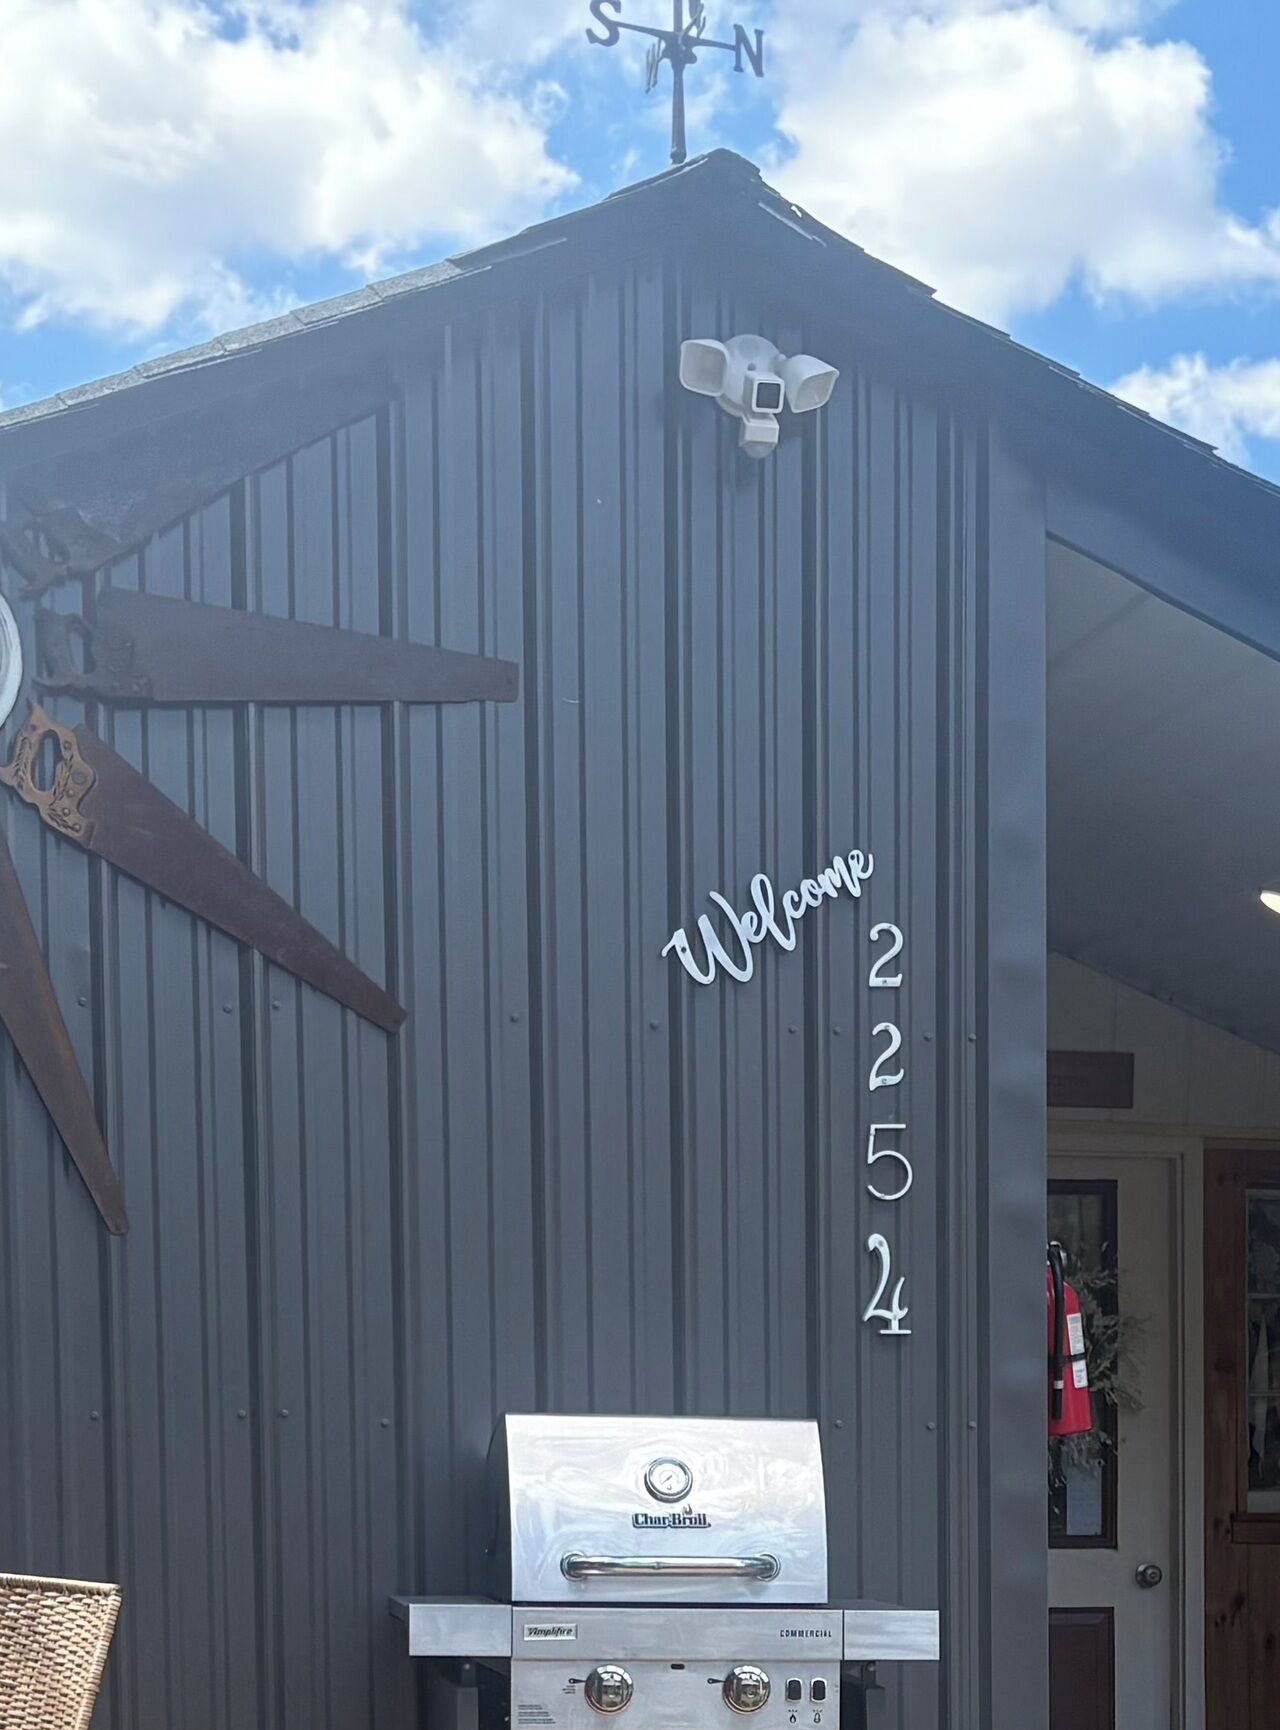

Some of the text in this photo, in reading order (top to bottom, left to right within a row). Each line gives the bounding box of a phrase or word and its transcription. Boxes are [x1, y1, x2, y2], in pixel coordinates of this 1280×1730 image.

[586, 0, 621, 47] S
[733, 24, 764, 78] N
[662, 849, 874, 985] Welcome
[863, 922, 913, 1335] 2254
[780, 1629, 831, 1638] COMMERCIAL
